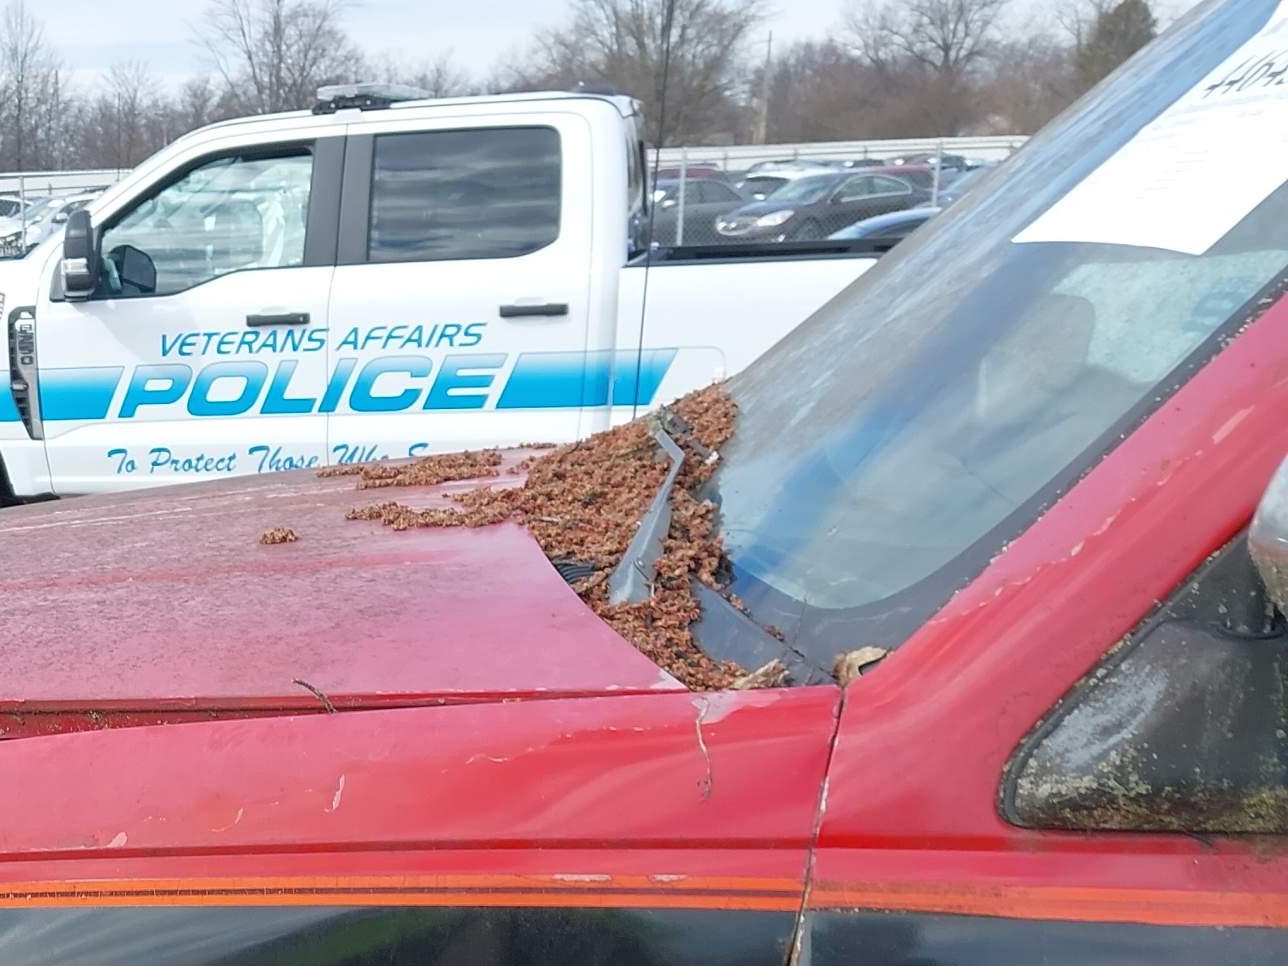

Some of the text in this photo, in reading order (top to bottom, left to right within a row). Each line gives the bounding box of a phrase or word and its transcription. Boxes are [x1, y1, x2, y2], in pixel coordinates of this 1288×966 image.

[160, 323, 485, 357] VETERANS AFFAIRS
[117, 352, 509, 418] POLICE
[107, 448, 137, 475] To
[148, 447, 238, 475] Protect
[248, 445, 320, 473] Those
